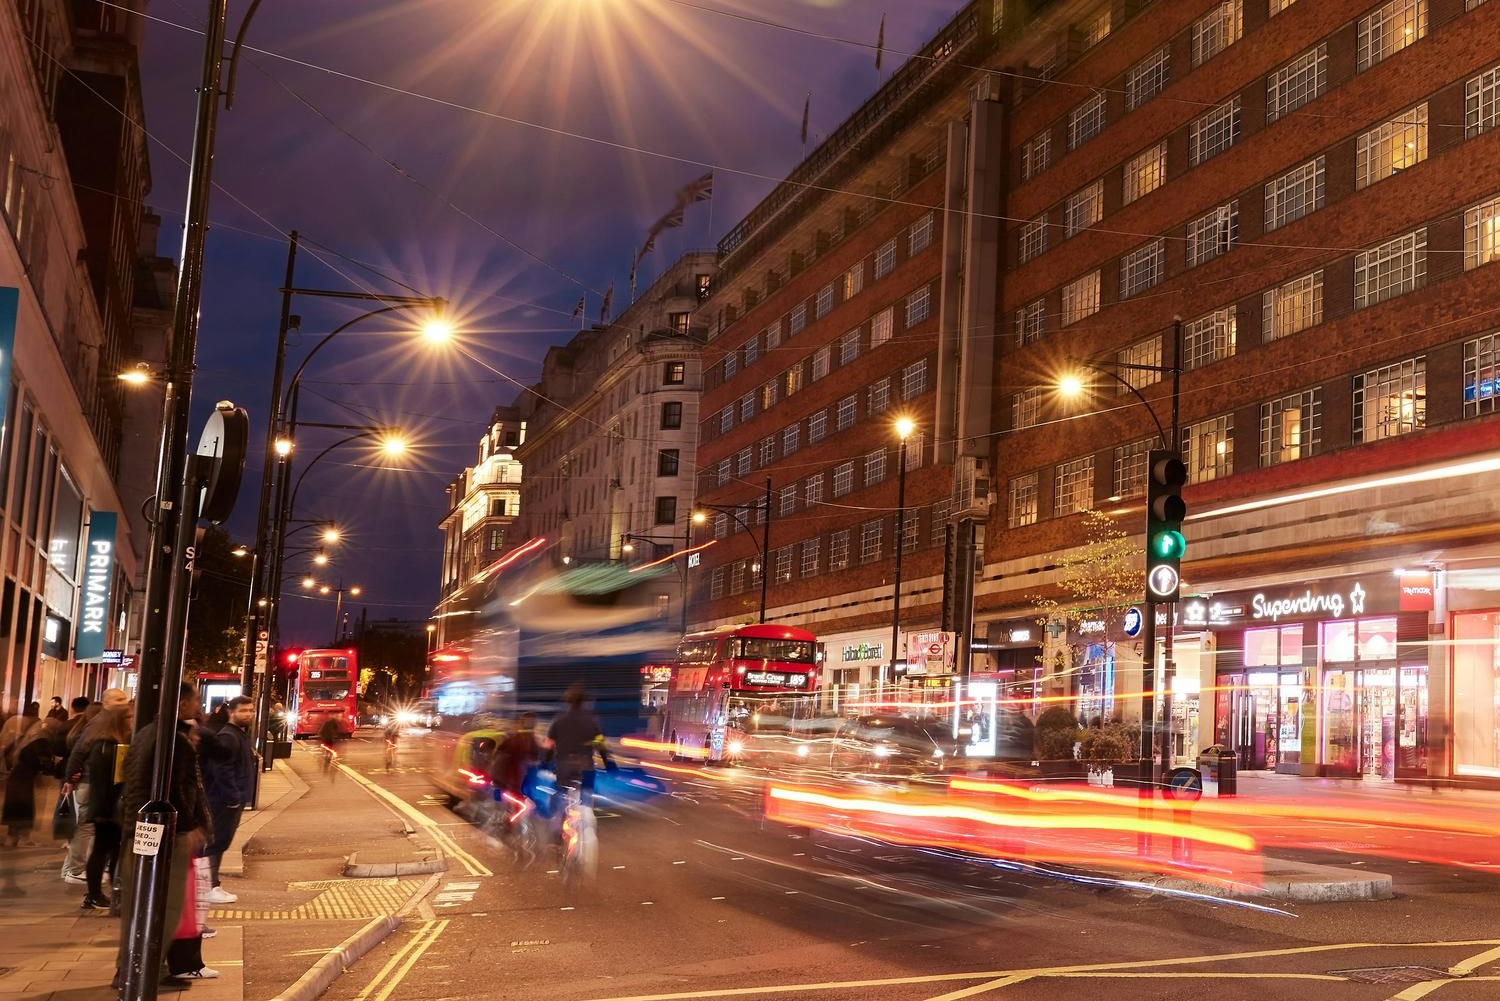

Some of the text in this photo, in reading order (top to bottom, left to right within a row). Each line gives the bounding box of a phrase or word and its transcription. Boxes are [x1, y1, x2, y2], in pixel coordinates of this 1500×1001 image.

[185, 546, 195, 559] S
[185, 561, 193, 572] 4
[82, 540, 112, 633] PRIMARK
[1253, 590, 1344, 621] Superdrug
